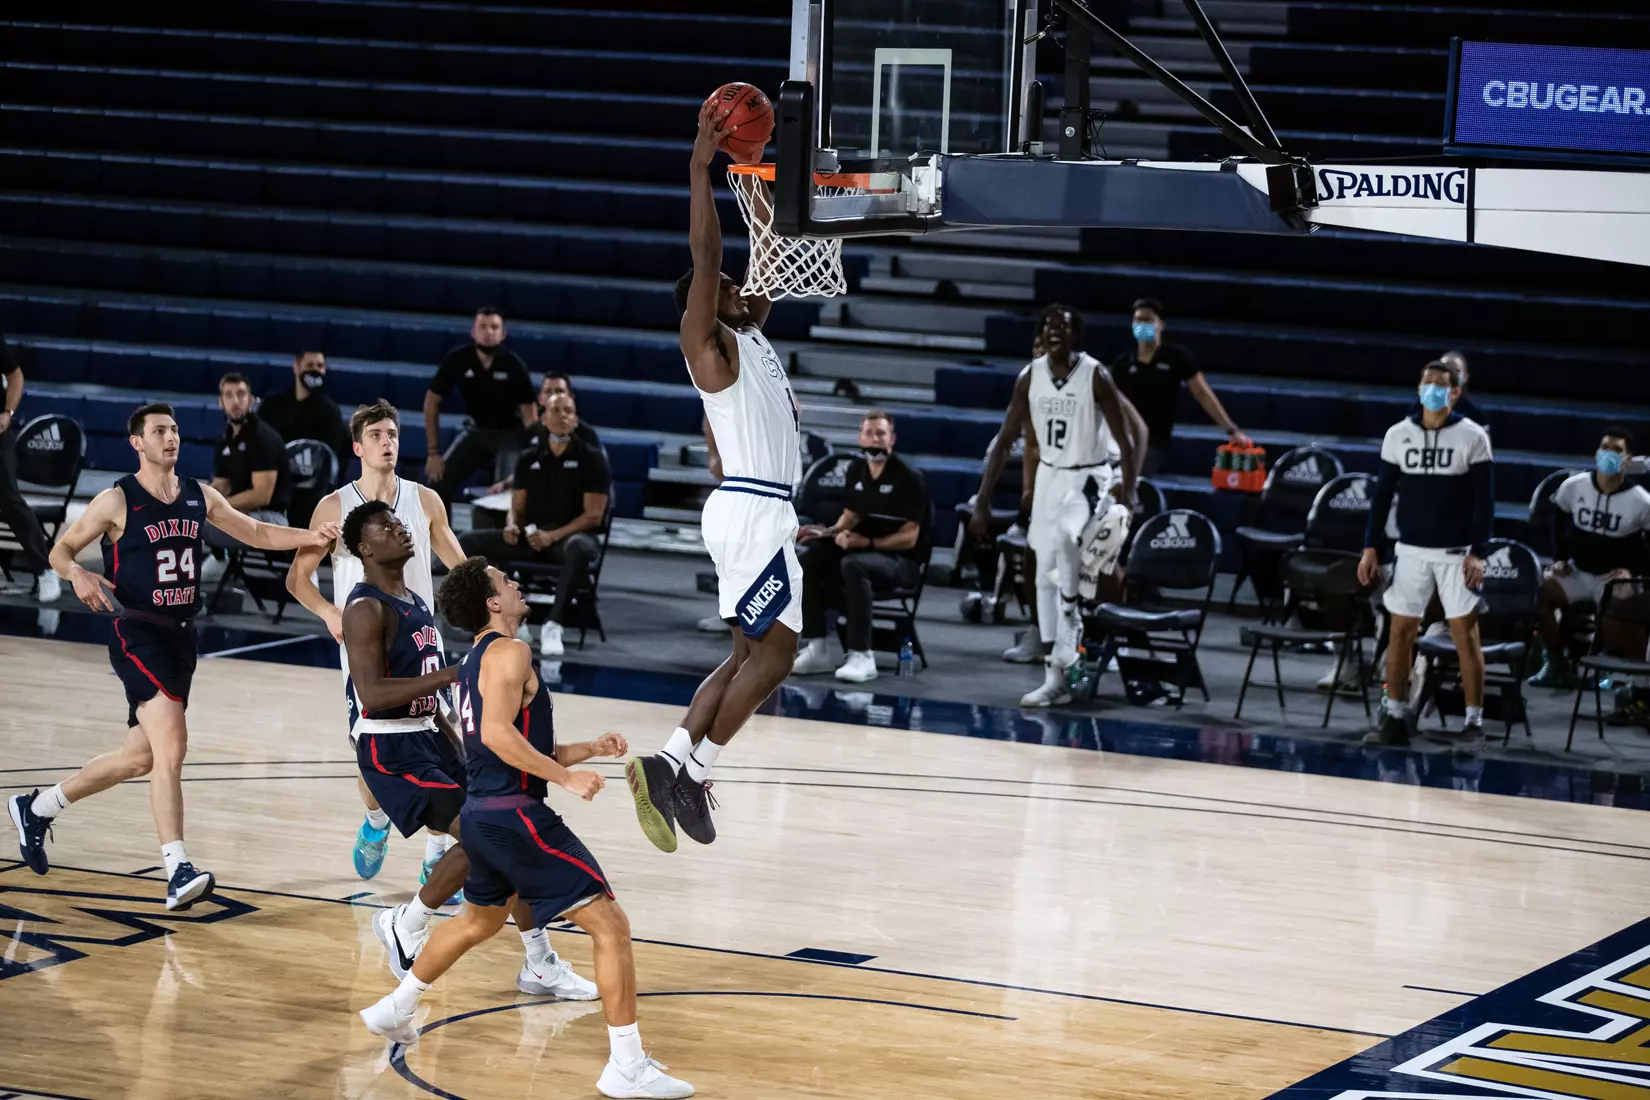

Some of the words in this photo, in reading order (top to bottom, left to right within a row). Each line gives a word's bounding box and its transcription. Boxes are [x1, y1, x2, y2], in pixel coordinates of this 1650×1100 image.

[1318, 168, 1466, 205] SPALDING
[1047, 418, 1067, 450] 12
[1405, 447, 1454, 468] CBU
[144, 518, 199, 543] DIXIE
[1578, 508, 1622, 532] CBU
[1150, 537, 1197, 549] adidas
[156, 546, 196, 583] 24
[1482, 567, 1519, 579] didas
[741, 574, 784, 626] LANCERS
